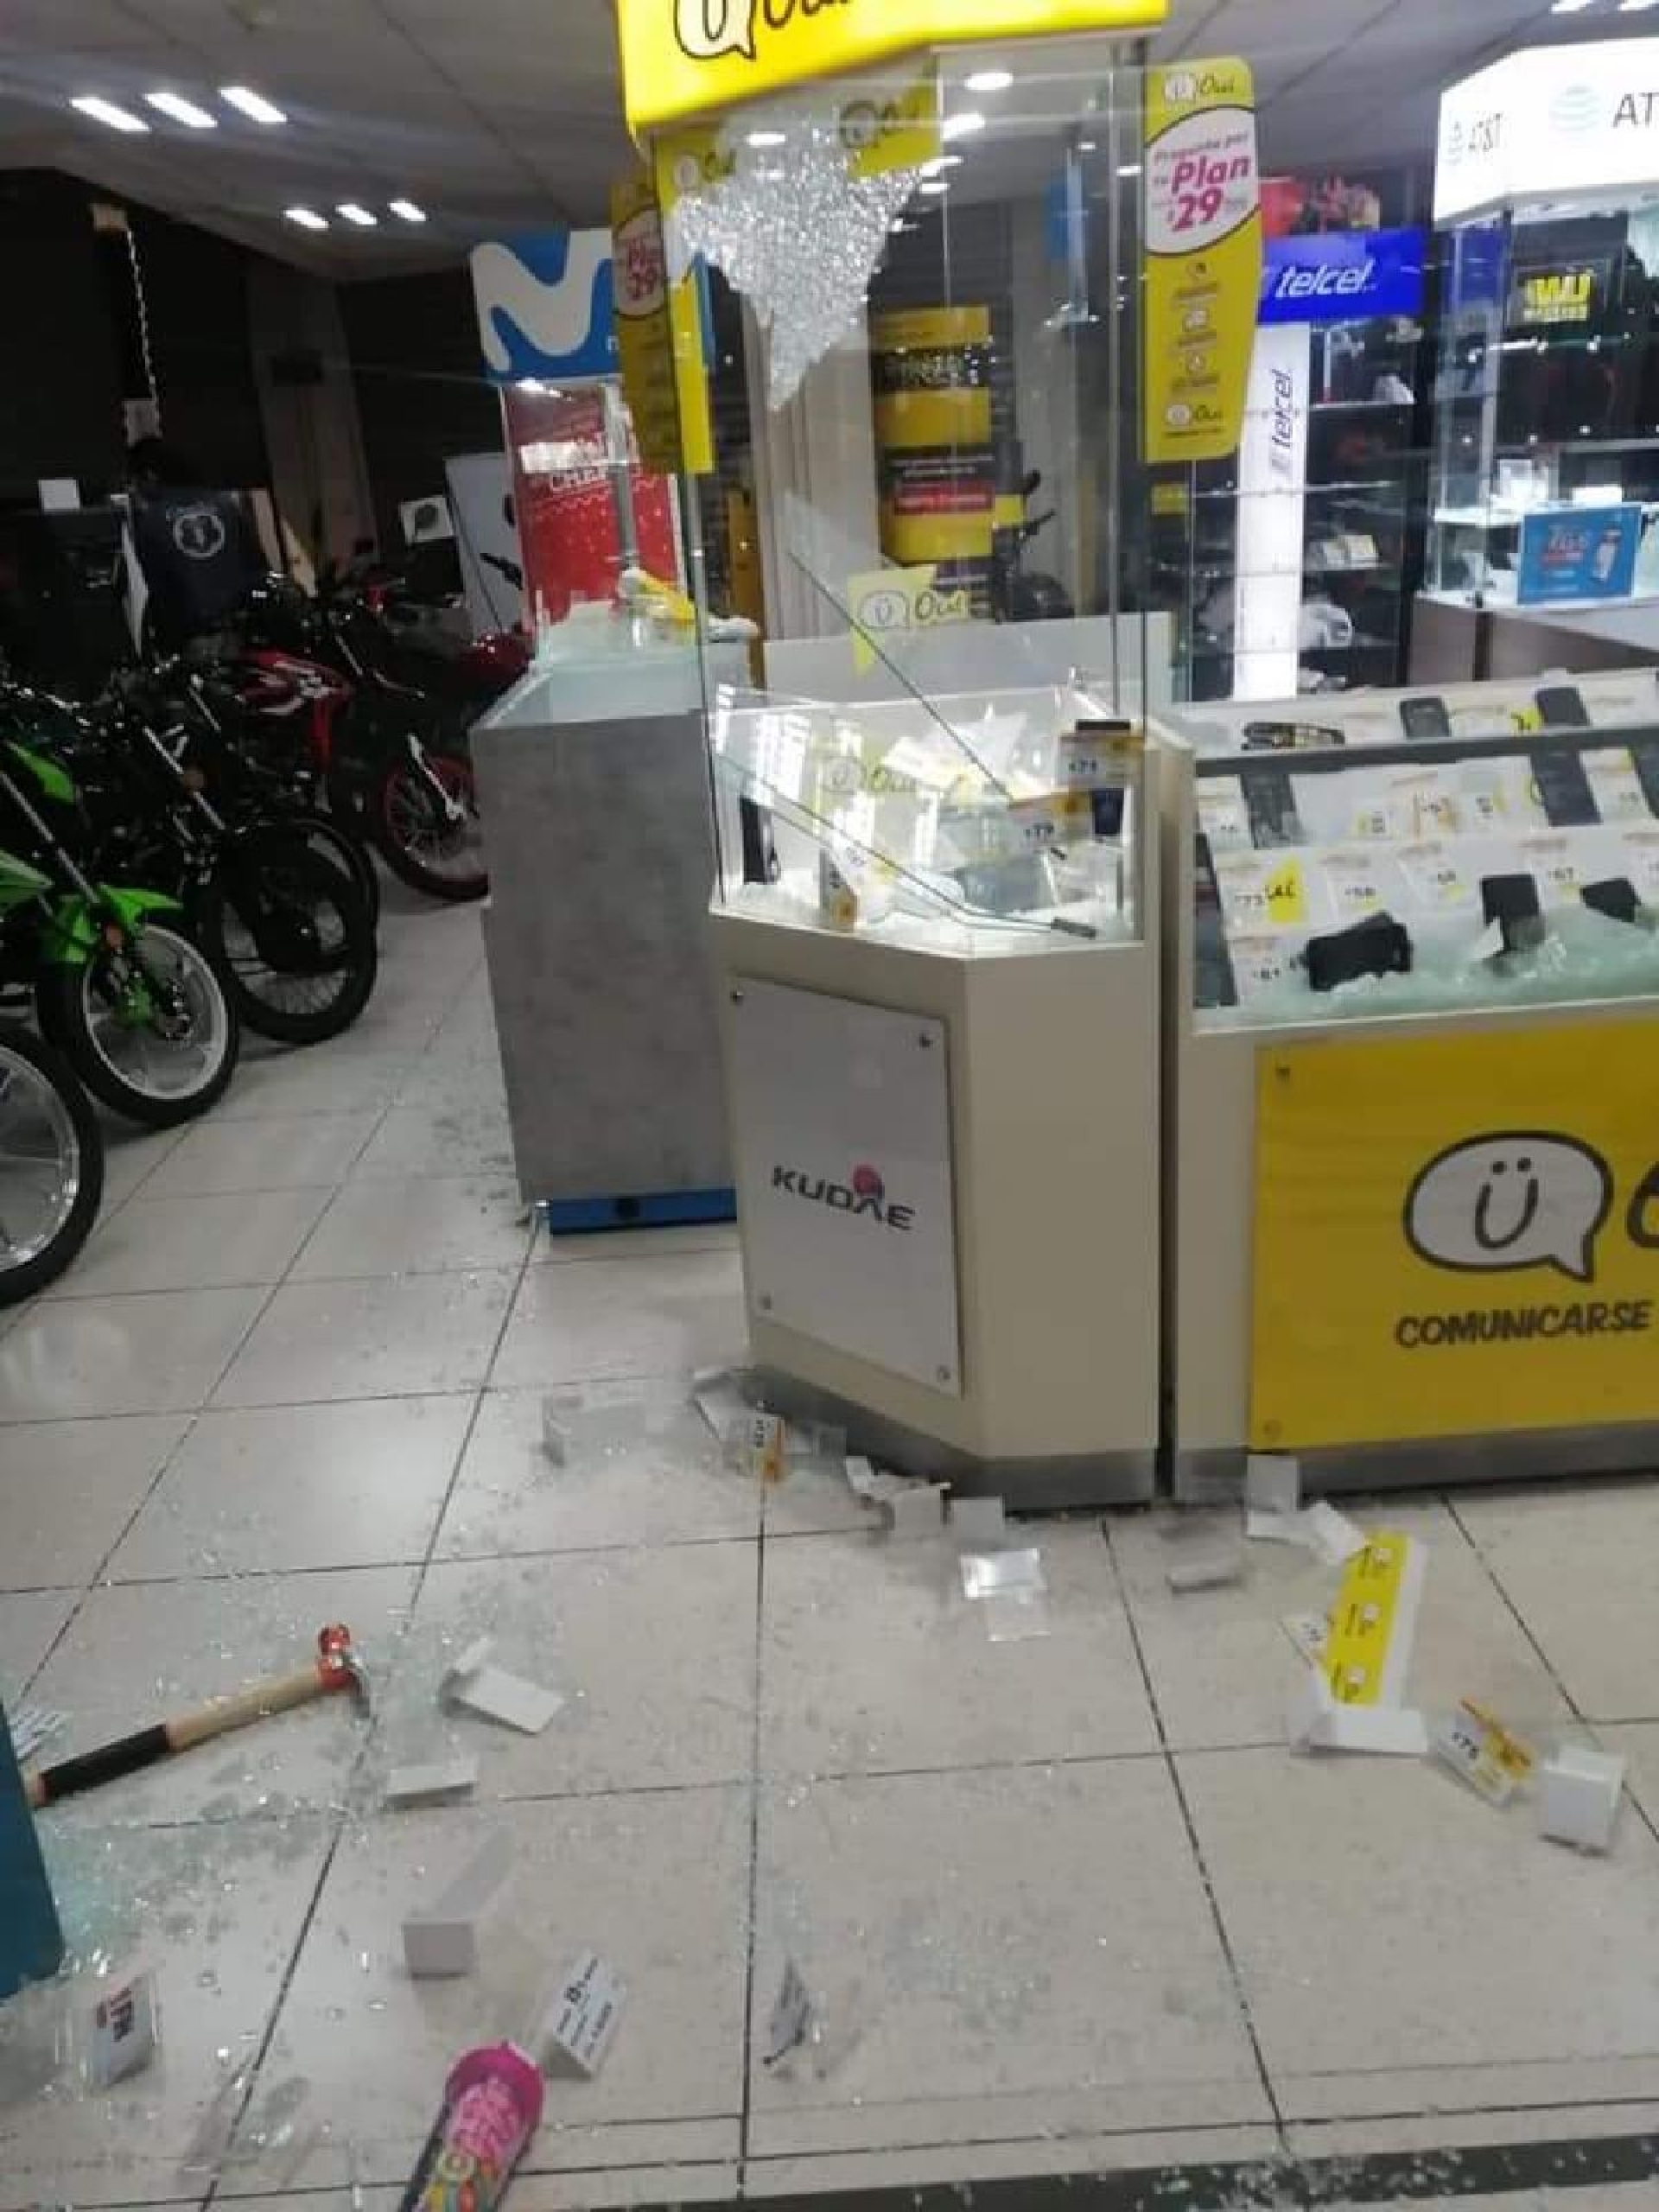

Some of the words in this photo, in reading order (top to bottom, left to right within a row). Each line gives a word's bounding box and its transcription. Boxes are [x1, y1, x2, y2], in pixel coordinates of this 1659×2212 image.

[1171, 155, 1250, 194] Plan
[1274, 257, 1376, 299] telcel
[1270, 366, 1294, 448] telcel
[1394, 1299, 1651, 1350] COMUNICARSE
